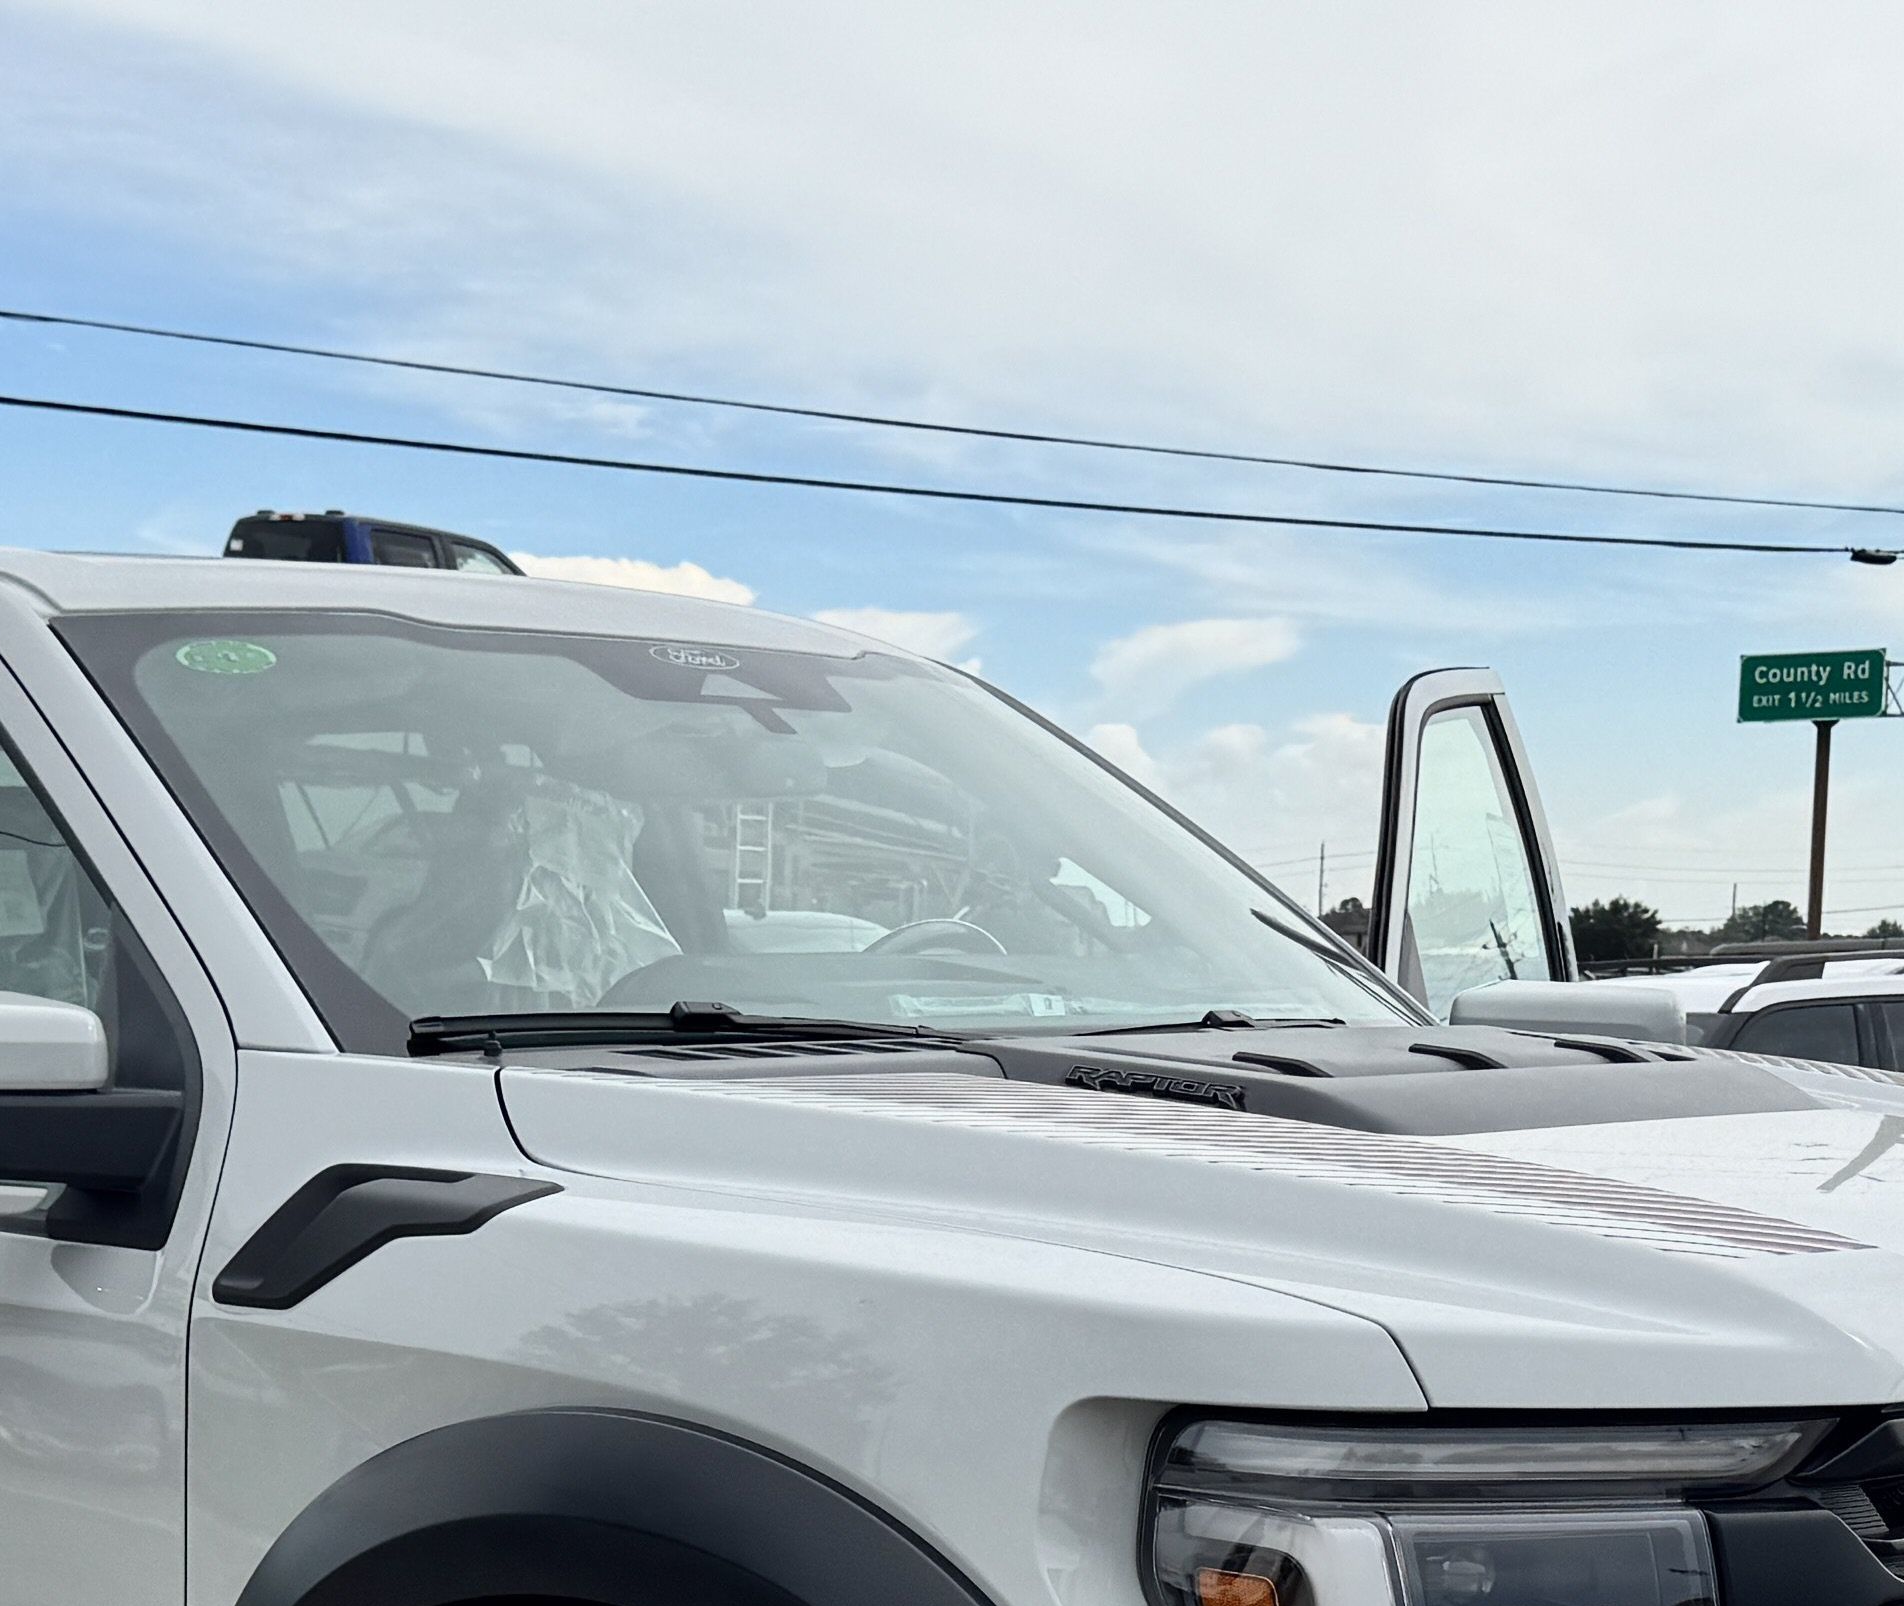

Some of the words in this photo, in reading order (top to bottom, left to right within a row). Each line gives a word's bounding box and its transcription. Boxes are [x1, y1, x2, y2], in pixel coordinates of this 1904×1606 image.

[1754, 664, 1831, 686] County
[1843, 660, 1870, 680] Rd
[1752, 694, 1781, 708] EXIT
[1829, 690, 1870, 705] MILES
[1065, 1064, 1244, 1110] RAPTOR
